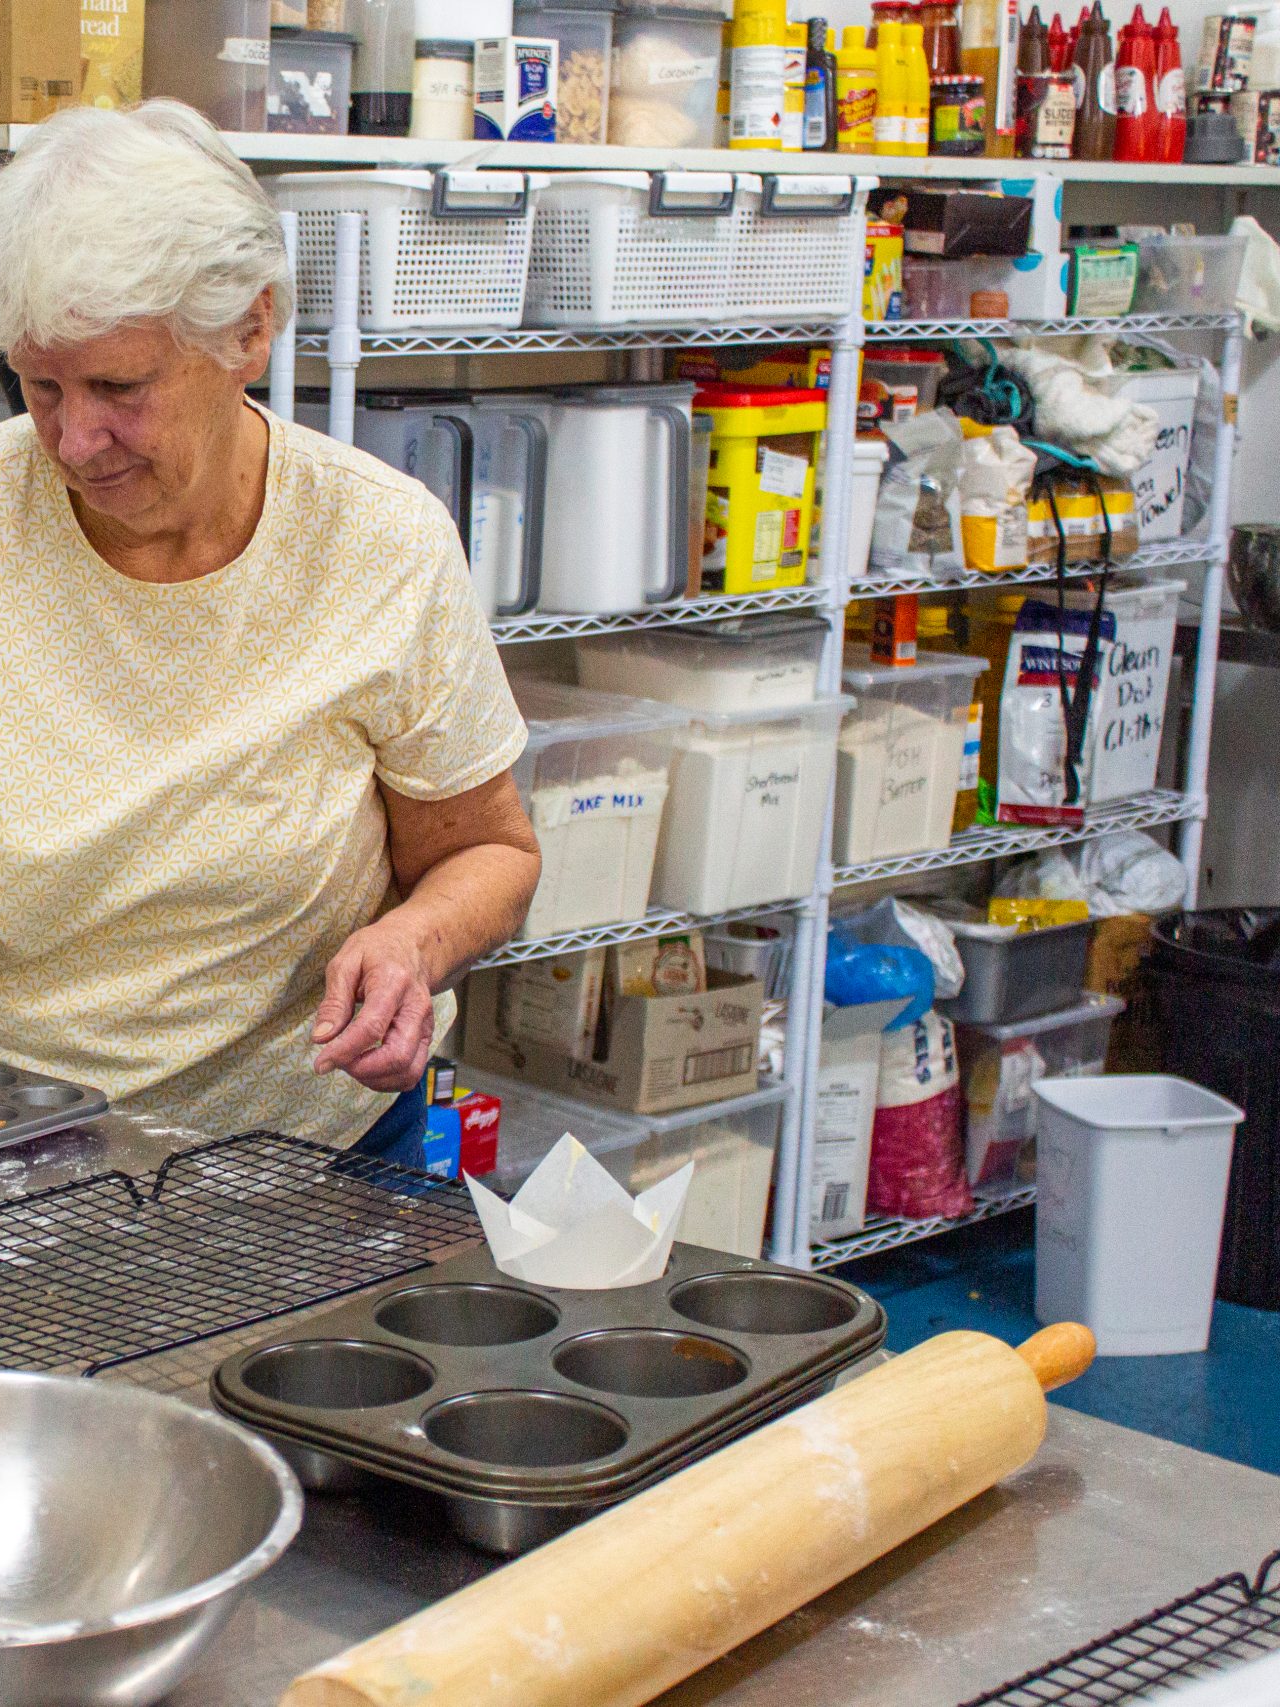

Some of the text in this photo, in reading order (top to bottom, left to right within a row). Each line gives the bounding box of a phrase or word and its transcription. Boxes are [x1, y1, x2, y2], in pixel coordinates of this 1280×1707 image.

[81, 16, 119, 36] read
[1155, 424, 1189, 451] ean
[571, 793, 645, 815] CAKE MIX
